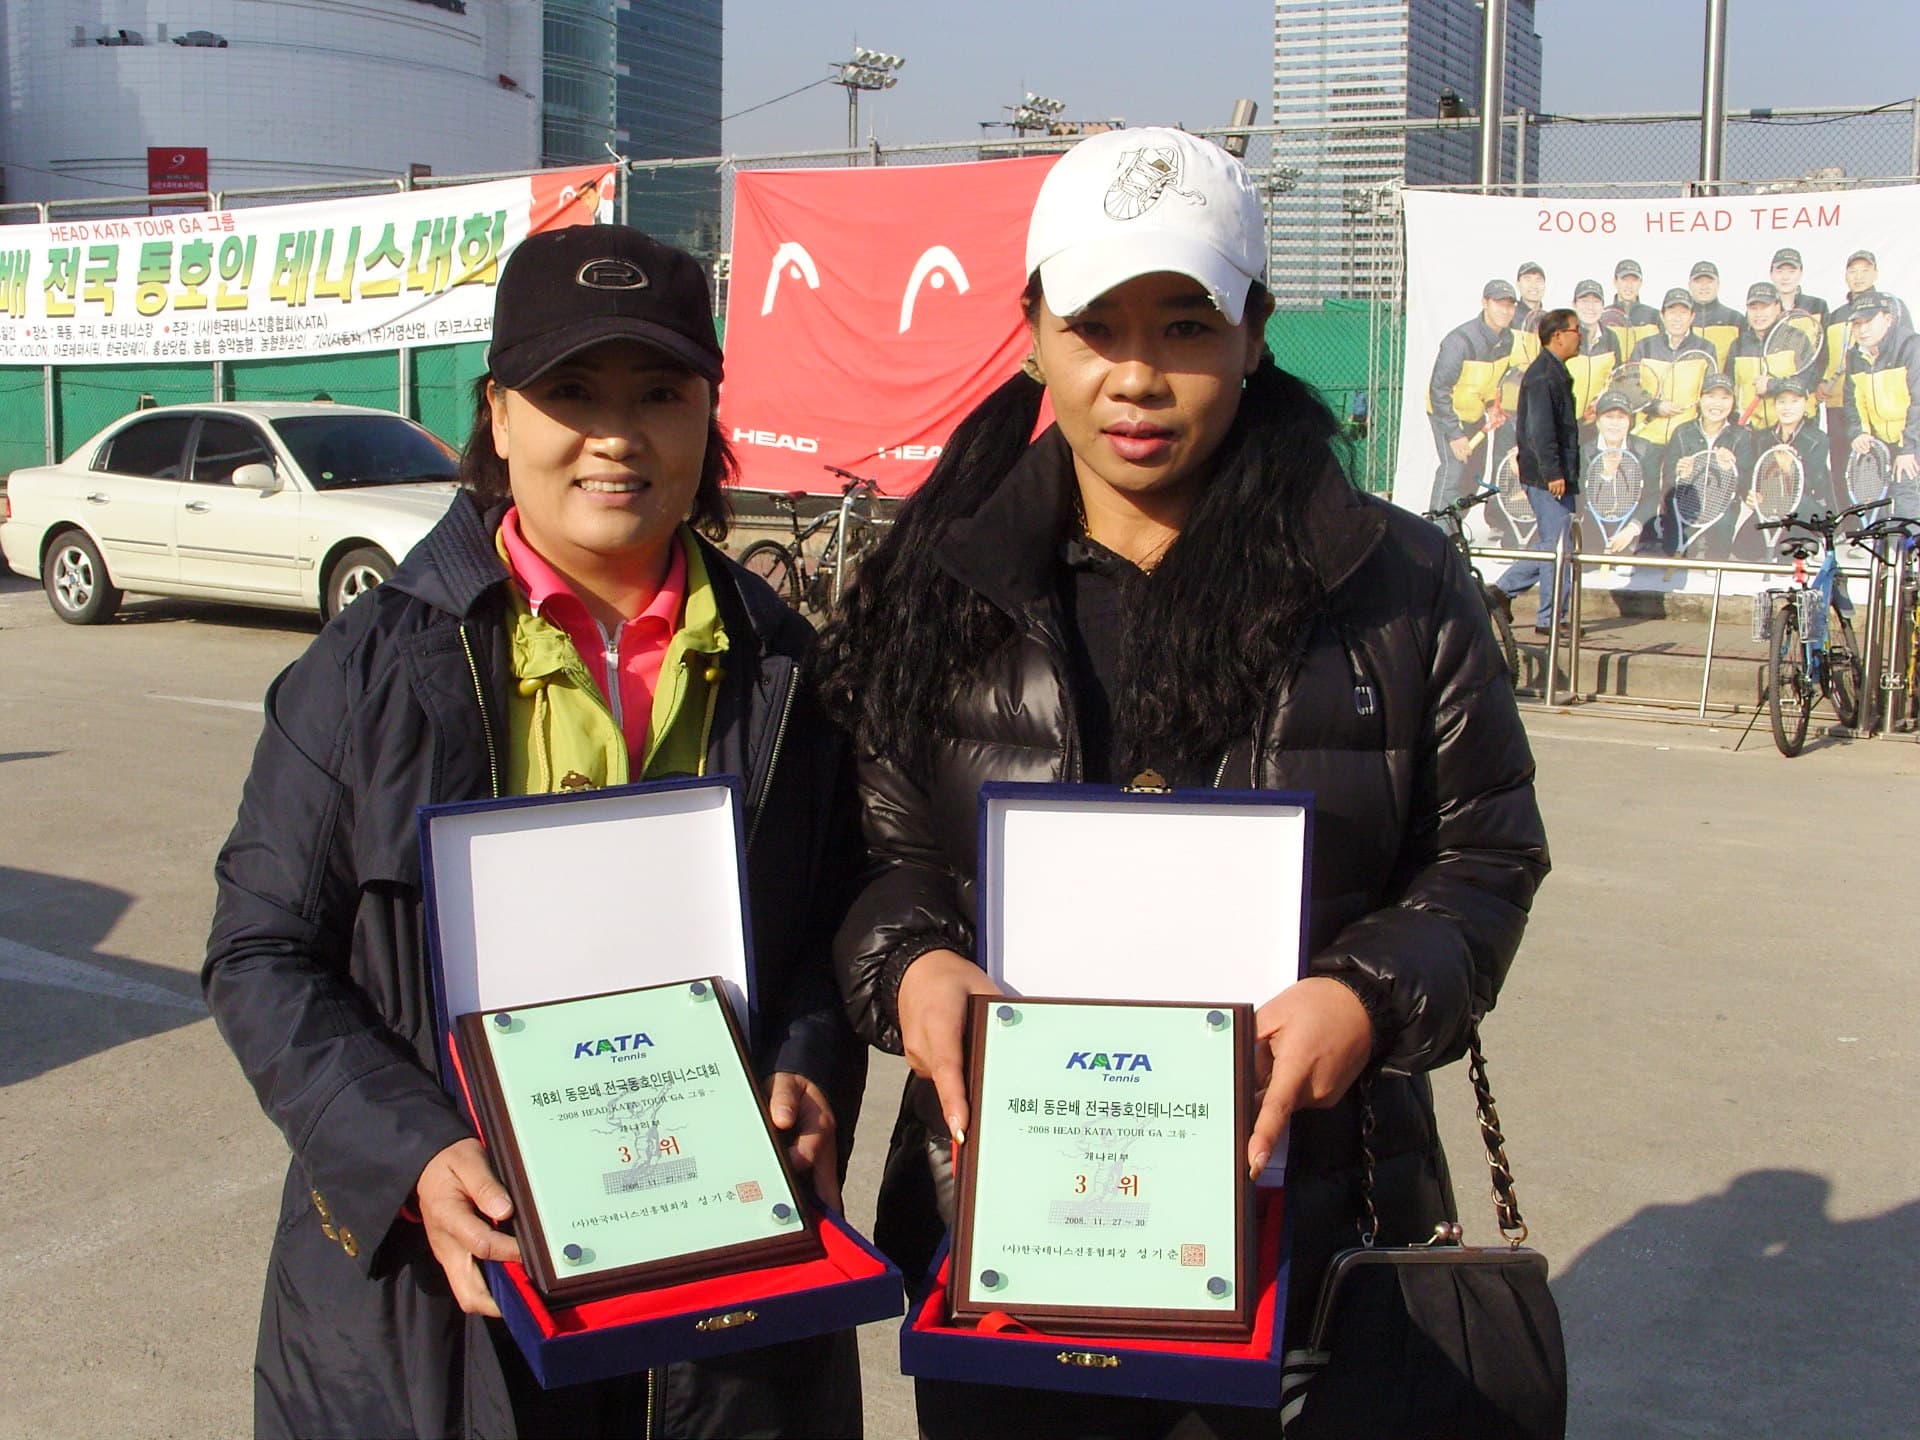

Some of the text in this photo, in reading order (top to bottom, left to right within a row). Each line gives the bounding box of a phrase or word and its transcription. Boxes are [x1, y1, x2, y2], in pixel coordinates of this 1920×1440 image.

[51, 213, 235, 242] HEAD KATA TOUR GA 그룹
[1538, 204, 1841, 233] 2008 HEAD TEAM
[44, 245, 119, 318] 전국
[135, 235, 257, 317] 동호인
[270, 210, 507, 307] 테니스대회
[172, 321, 189, 336] 주관
[733, 428, 818, 453] HEAD
[878, 445, 943, 460] HEA
[574, 1032, 655, 1059] KATA
[610, 1051, 647, 1064] Tennis
[1065, 1052, 1153, 1072] KATA
[530, 1062, 721, 1107] 제8회 동운배 전국동호인테니스대회
[1102, 1073, 1140, 1083] Tennis
[558, 1111, 579, 1122] 2008
[582, 1106, 609, 1118] HEAD
[610, 1101, 638, 1112] KATA
[670, 1093, 684, 1102] GA
[1007, 1098, 1209, 1120] 제8회 동운배 전국동호인테니스대회
[1027, 1125, 1050, 1135] 2008
[1053, 1126, 1081, 1135] HEAD
[1084, 1127, 1113, 1136] KATA
[1117, 1128, 1145, 1137] TOUR
[1148, 1129, 1162, 1138] GA
[618, 1136, 680, 1163] 3 위
[1084, 1151, 1129, 1163] 개나리부
[1074, 1174, 1138, 1197] 3 위
